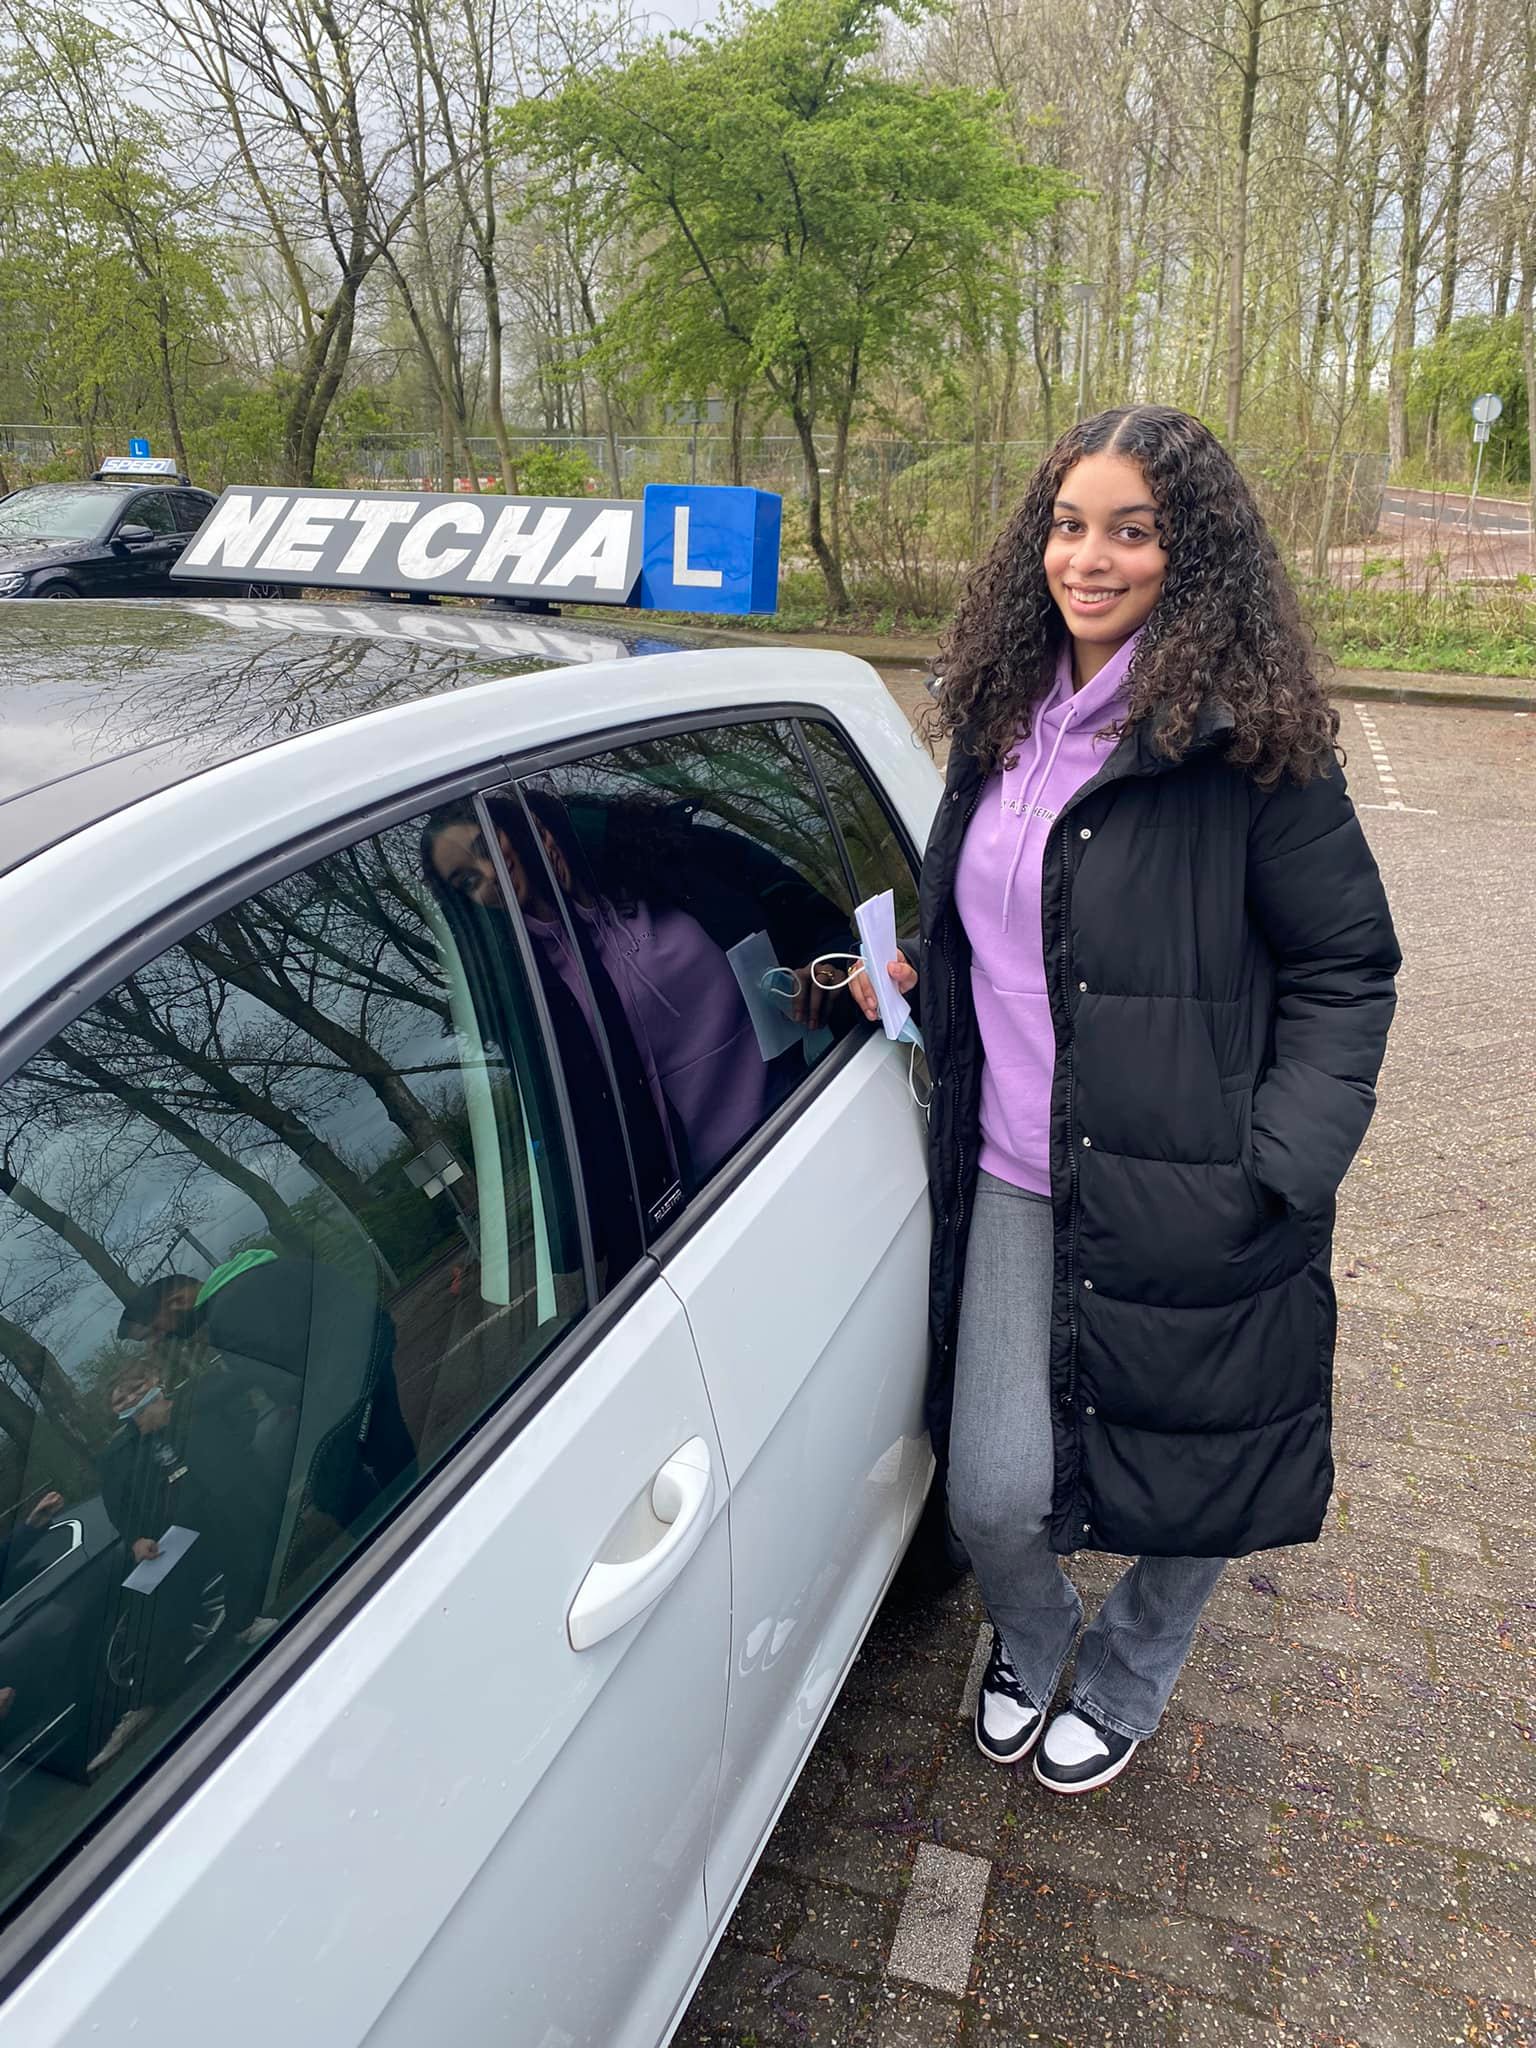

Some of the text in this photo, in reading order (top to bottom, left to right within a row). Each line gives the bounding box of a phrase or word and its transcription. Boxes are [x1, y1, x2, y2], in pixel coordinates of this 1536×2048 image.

[134, 442, 143, 455] L
[184, 494, 634, 590] NETCHA
[672, 506, 722, 588] L
